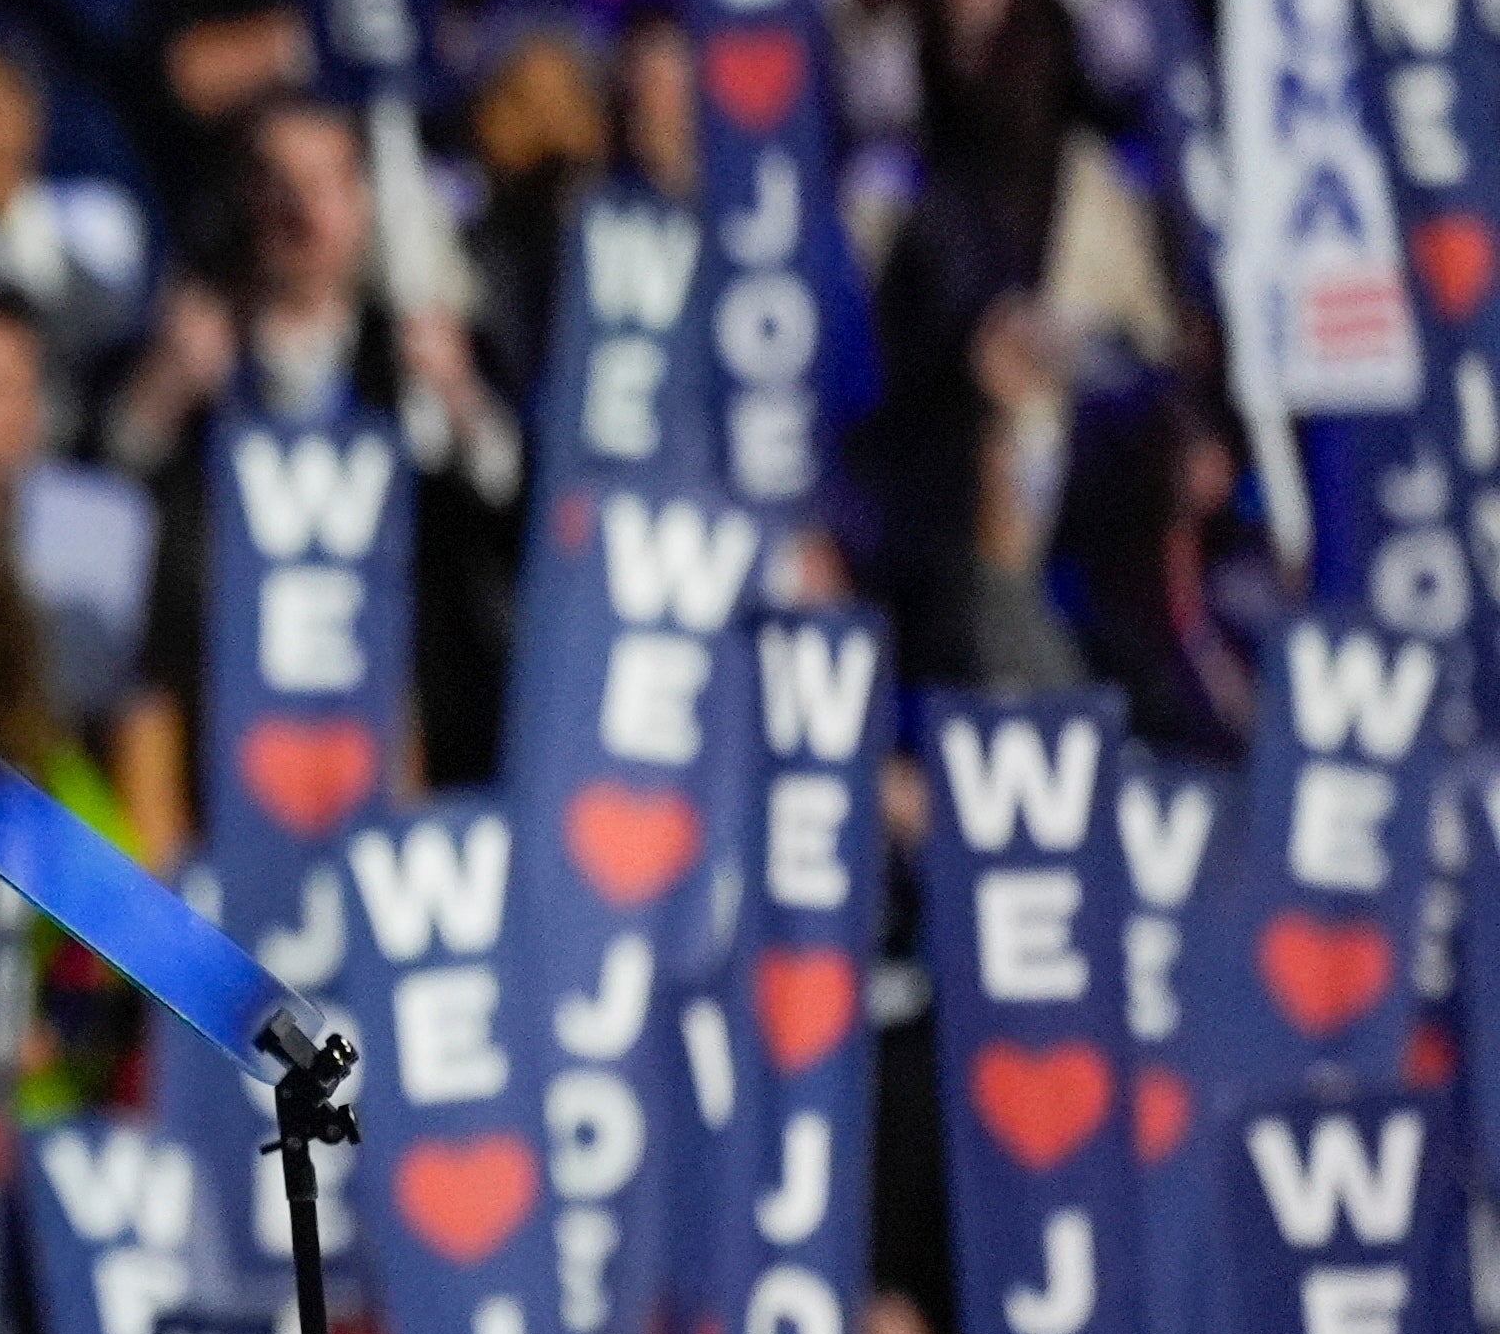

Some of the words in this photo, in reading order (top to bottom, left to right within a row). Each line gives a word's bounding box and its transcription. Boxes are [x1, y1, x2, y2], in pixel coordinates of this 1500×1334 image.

[577, 220, 692, 464] WE
[712, 157, 820, 514] JOE
[235, 435, 397, 699] WE
[595, 500, 762, 769] WE
[758, 622, 880, 914] WE
[940, 715, 1102, 1004] WE
[1285, 622, 1442, 894] WE
[345, 830, 507, 1109] WE
